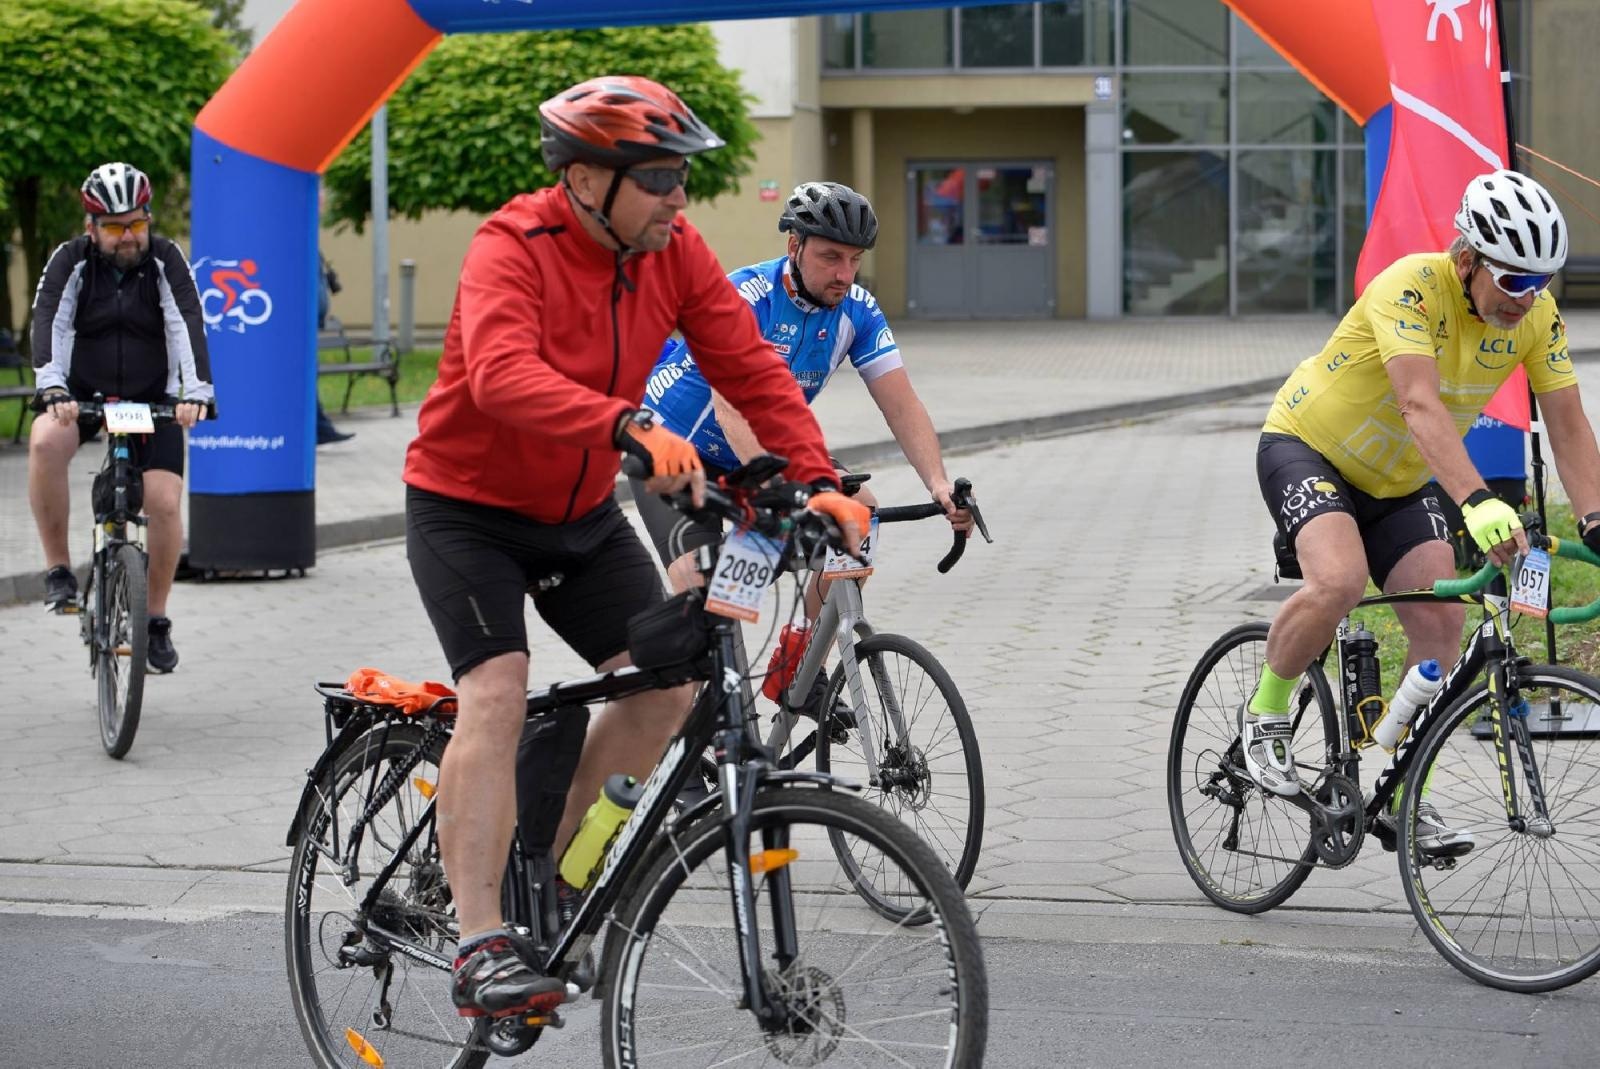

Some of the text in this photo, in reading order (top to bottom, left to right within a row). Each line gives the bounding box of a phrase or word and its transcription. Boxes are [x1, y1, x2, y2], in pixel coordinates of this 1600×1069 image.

[1480, 338, 1517, 354] LCL
[1327, 351, 1352, 372] LCL
[1286, 386, 1310, 410] LCL
[719, 554, 769, 589] 2089
[1521, 568, 1544, 591] 057
